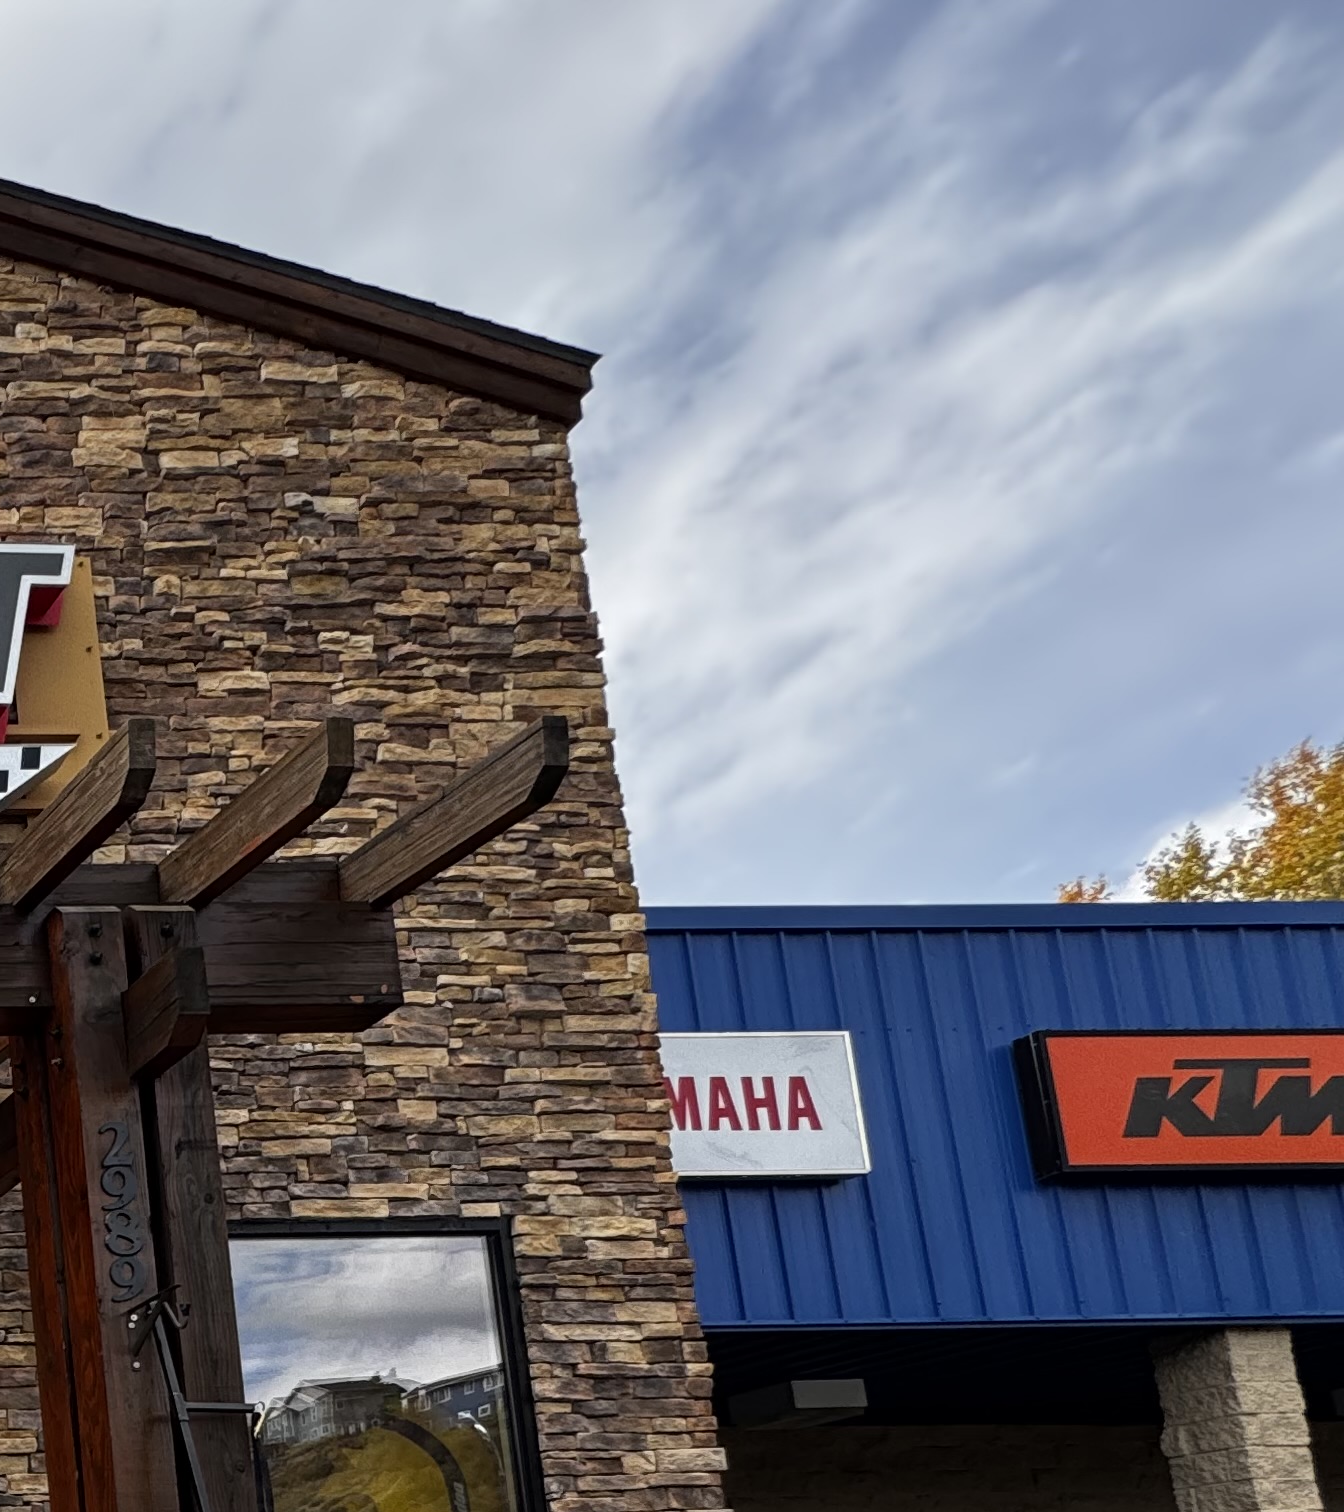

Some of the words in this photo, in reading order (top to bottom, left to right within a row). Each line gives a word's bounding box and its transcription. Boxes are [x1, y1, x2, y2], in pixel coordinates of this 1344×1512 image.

[663, 1076, 823, 1131] MAHA
[1122, 1058, 1344, 1138] KTM
[98, 1121, 146, 1302] 2989
